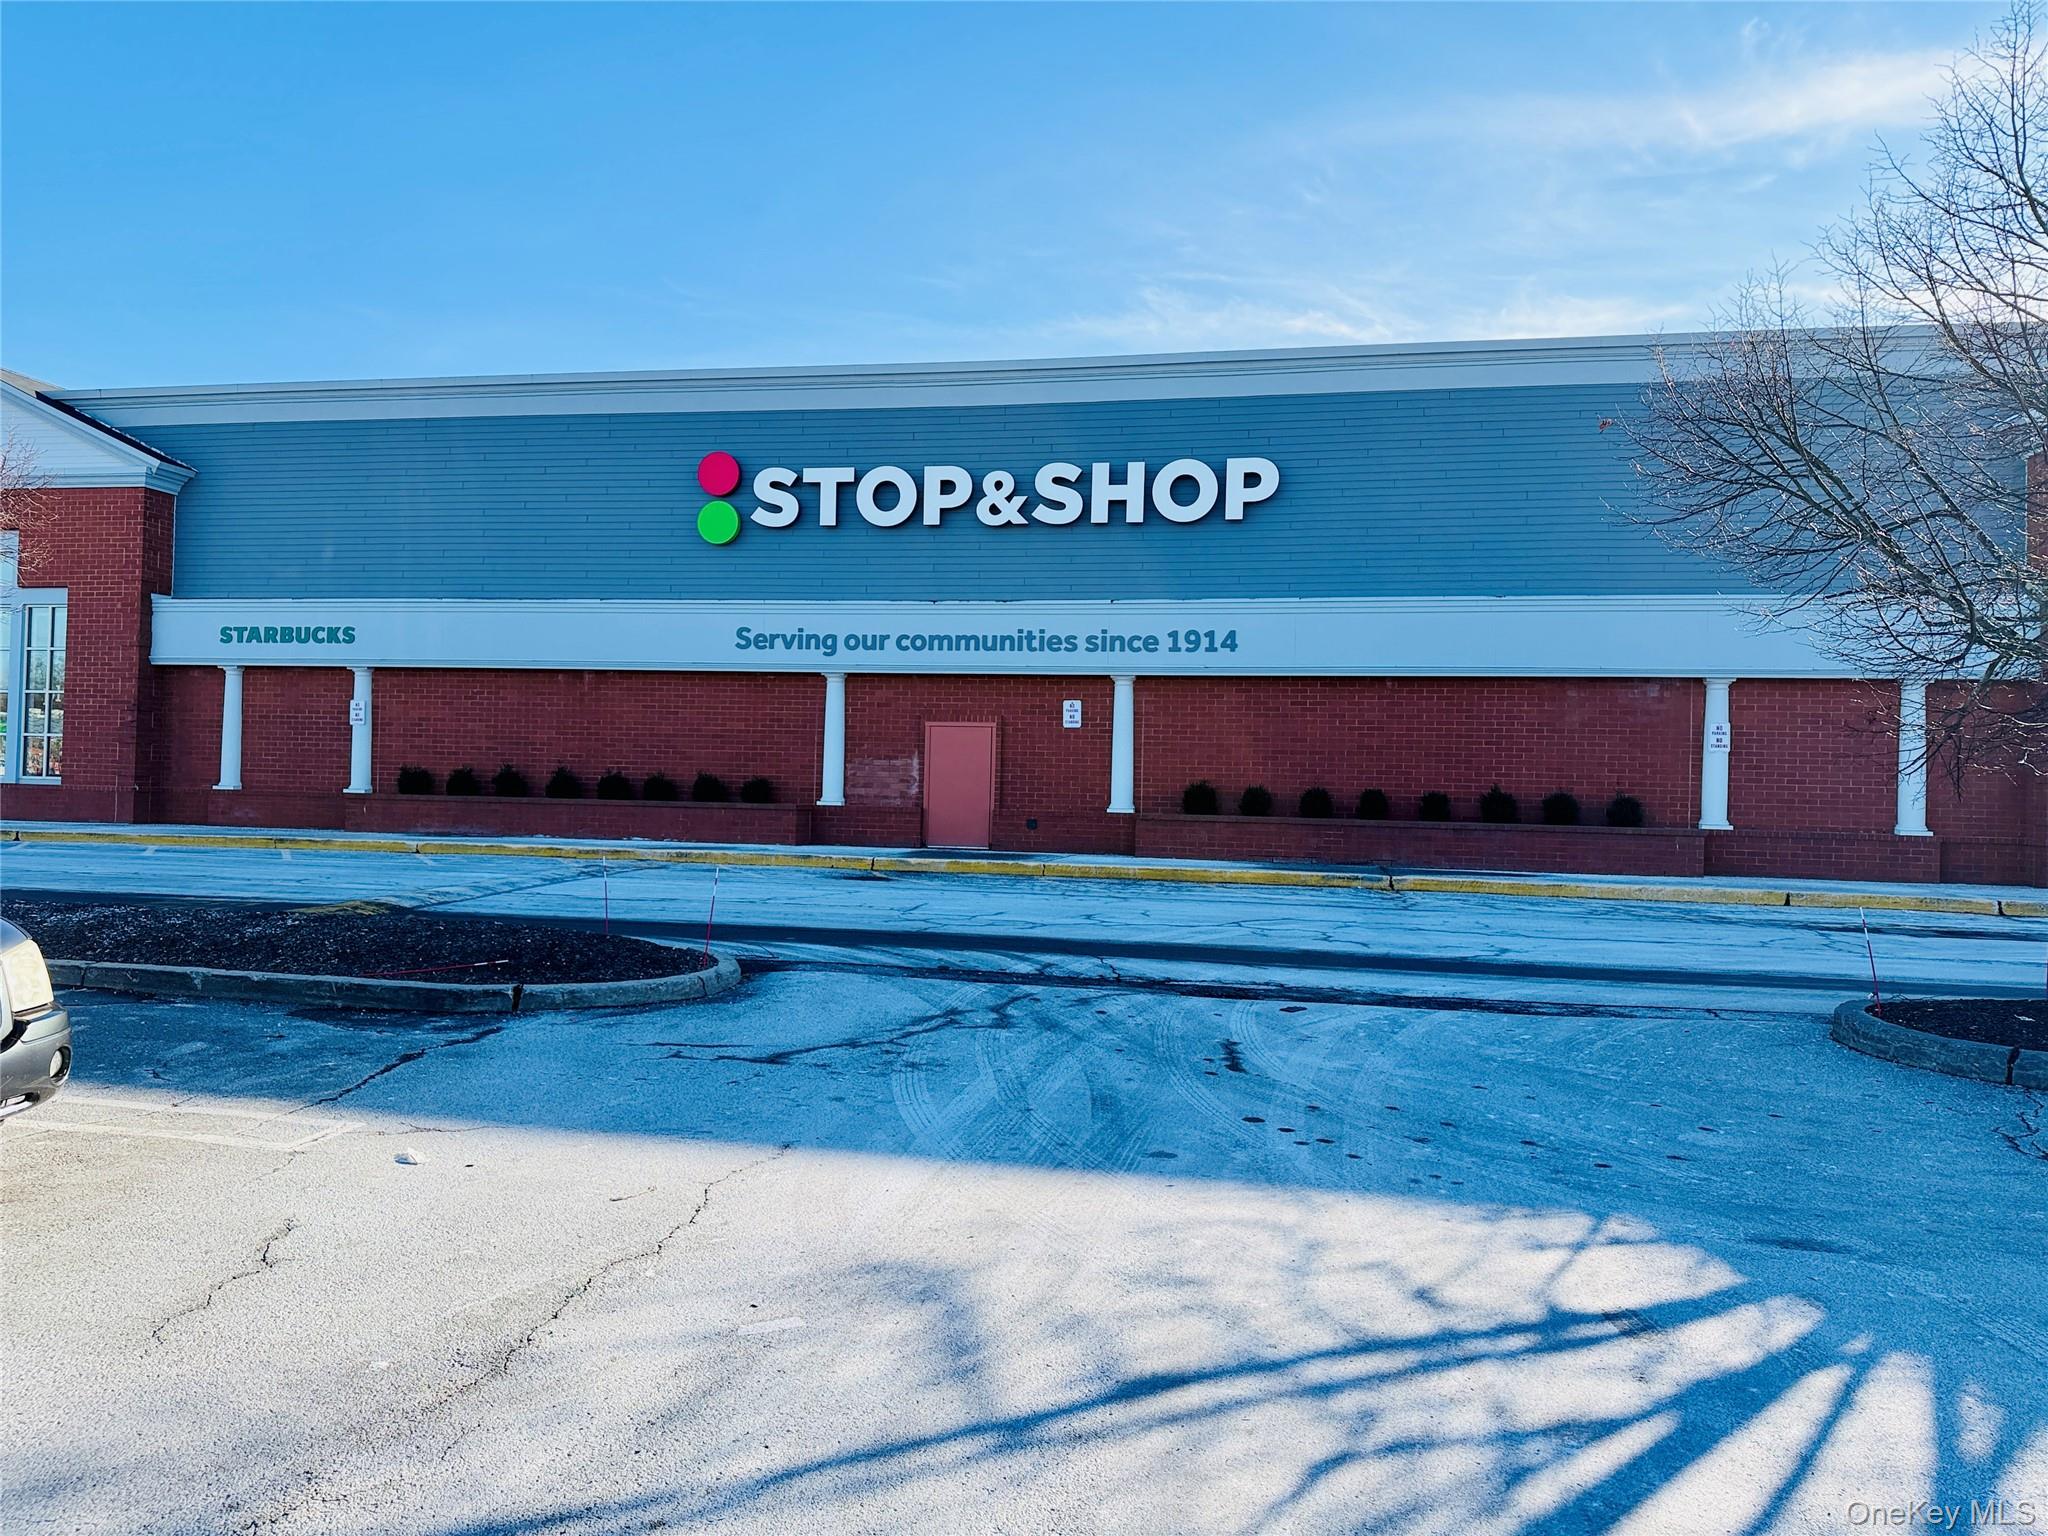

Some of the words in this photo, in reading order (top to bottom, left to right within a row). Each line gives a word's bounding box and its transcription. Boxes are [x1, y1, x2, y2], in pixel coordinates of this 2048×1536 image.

[750, 457, 1280, 528] STOP&SHOP
[219, 625, 356, 645] STARBUCKS
[734, 626, 838, 657] Serving
[843, 633, 891, 651] our
[895, 628, 1079, 653] communities
[1084, 628, 1160, 653] since
[1166, 629, 1239, 653] 1914
